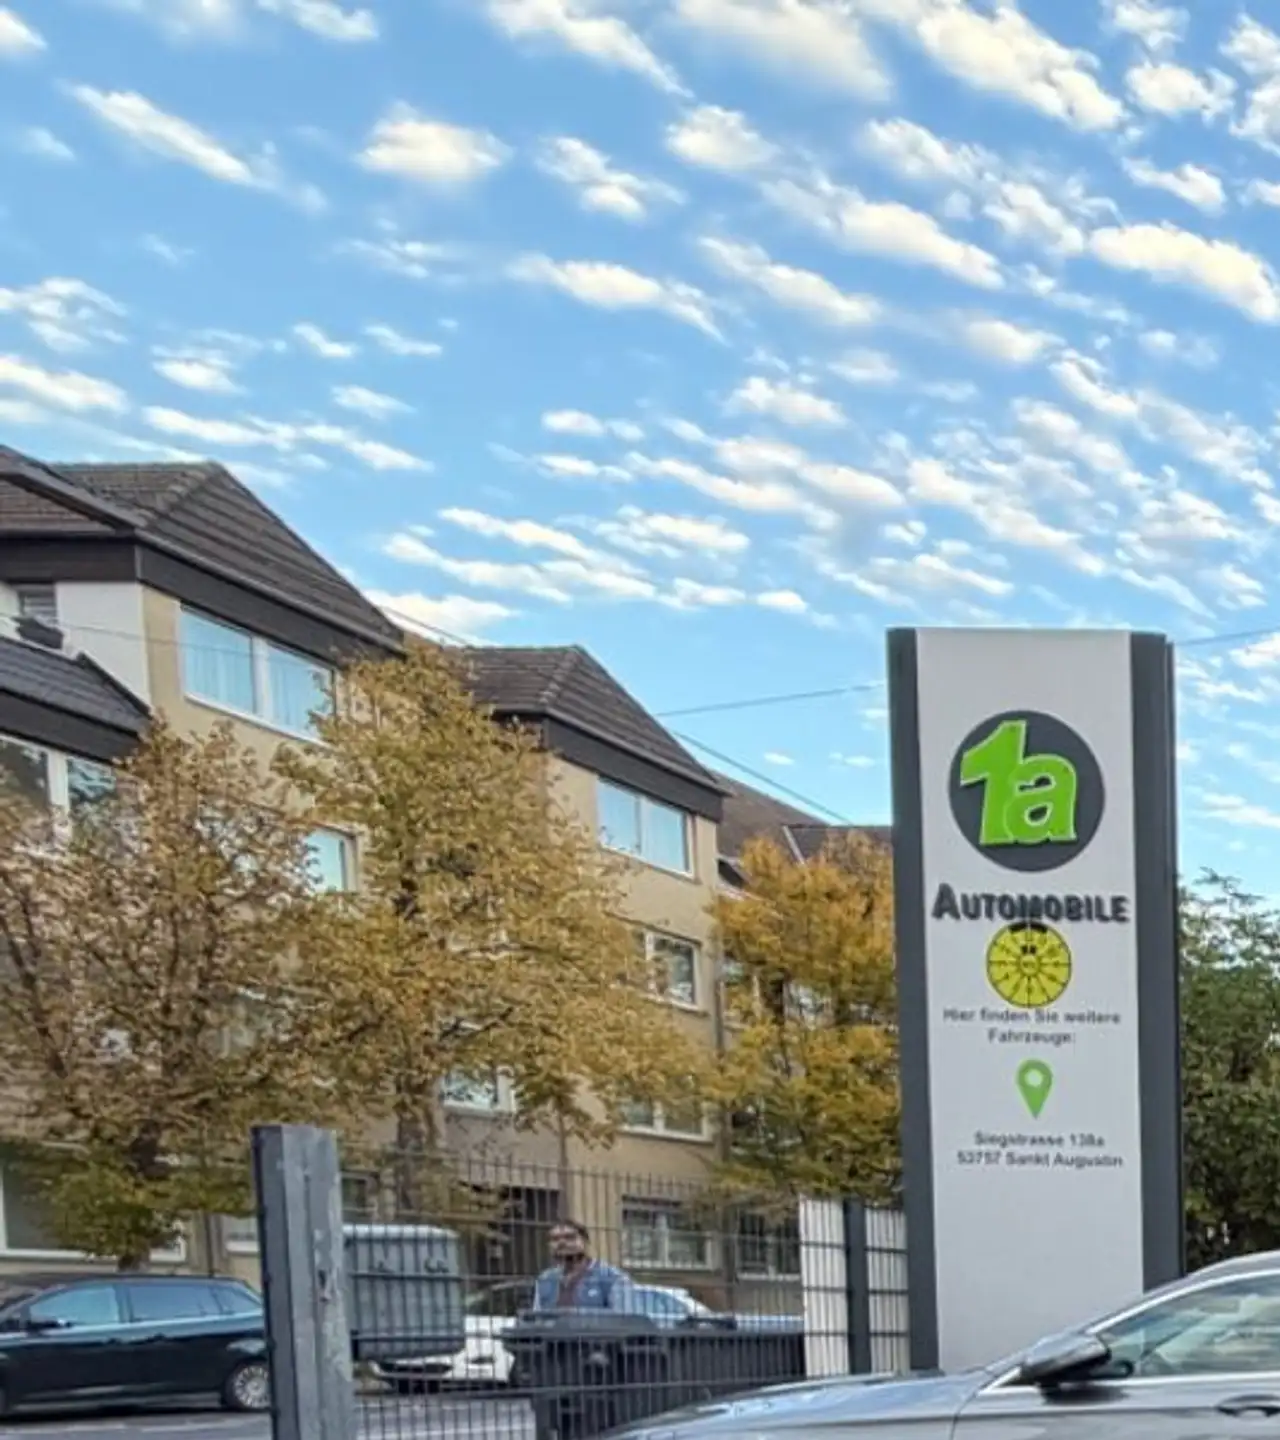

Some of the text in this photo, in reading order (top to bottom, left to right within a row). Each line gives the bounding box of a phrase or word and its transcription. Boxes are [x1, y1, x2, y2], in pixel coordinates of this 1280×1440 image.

[960, 719, 1078, 845] 1a
[932, 883, 1130, 922] AUTOMOBILE
[943, 1007, 1121, 1024] Hier finden Sie weitere
[1006, 1151, 1050, 1167] Sankt
[1053, 1152, 1123, 1169] Augustin
